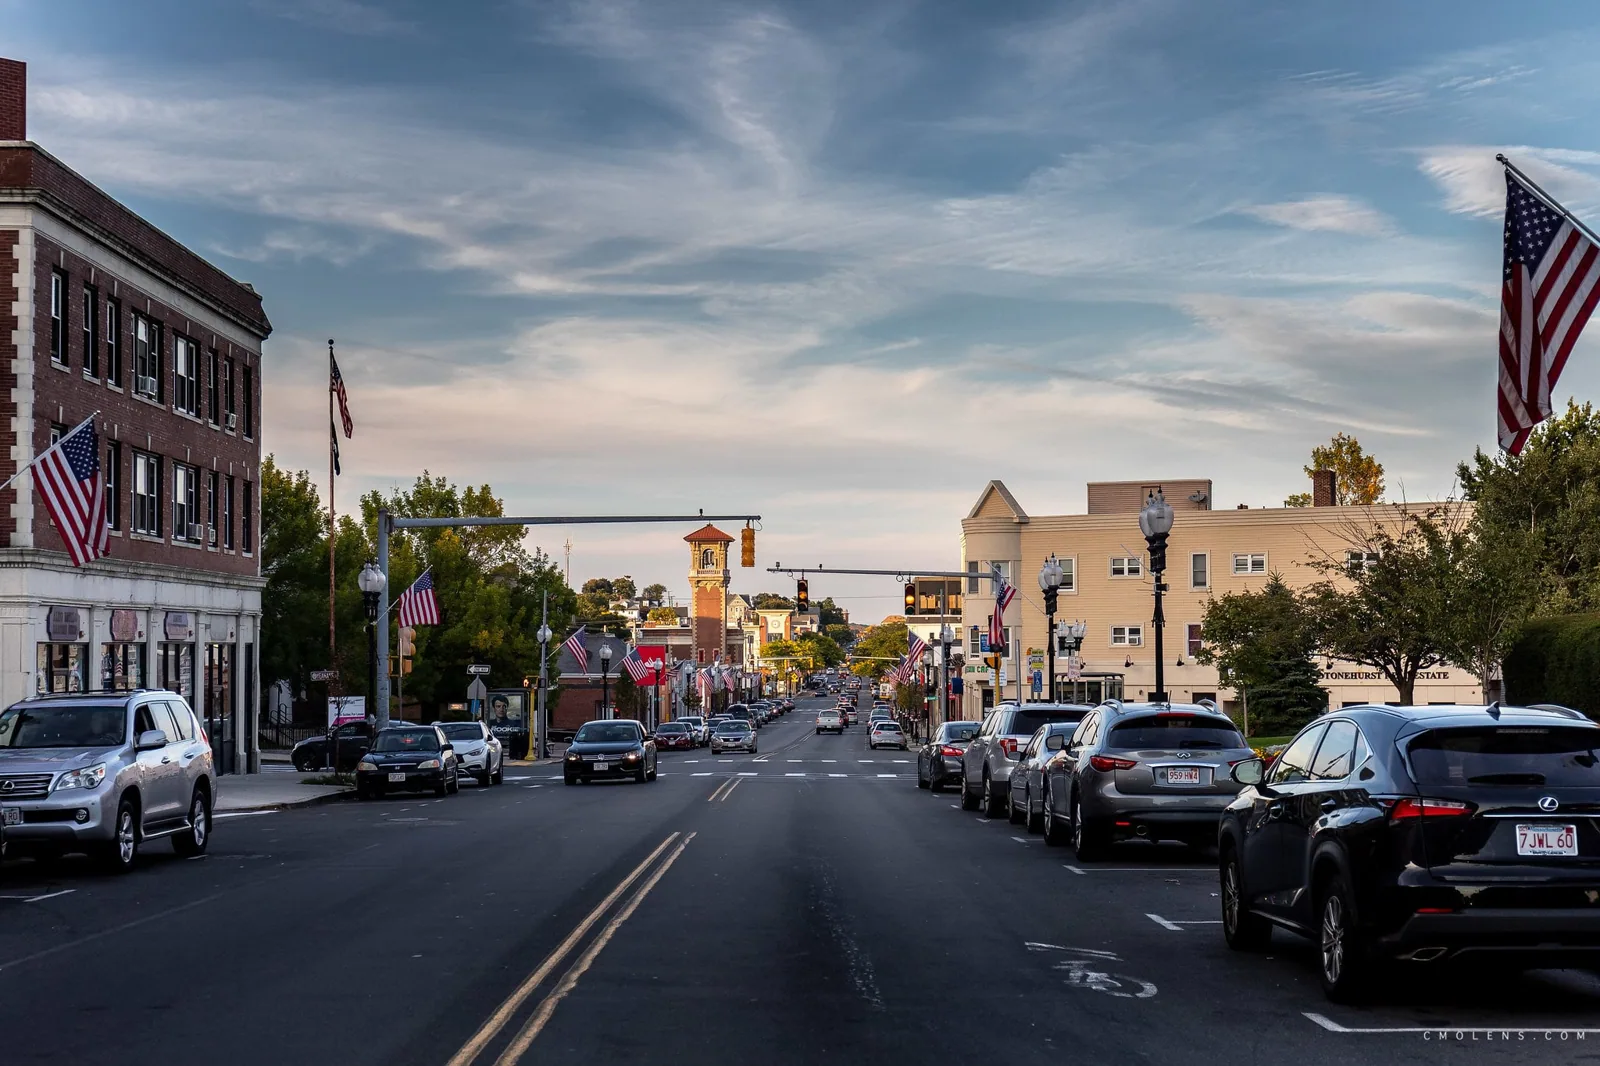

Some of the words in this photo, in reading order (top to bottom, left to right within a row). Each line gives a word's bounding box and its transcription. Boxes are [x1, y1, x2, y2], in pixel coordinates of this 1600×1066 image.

[1319, 669, 1382, 680] STONEHURST
[1169, 771, 1182, 780] 959
[1184, 771, 1198, 780] HW4
[1519, 832, 1553, 849] 7JWL
[1557, 833, 1573, 848] 60
